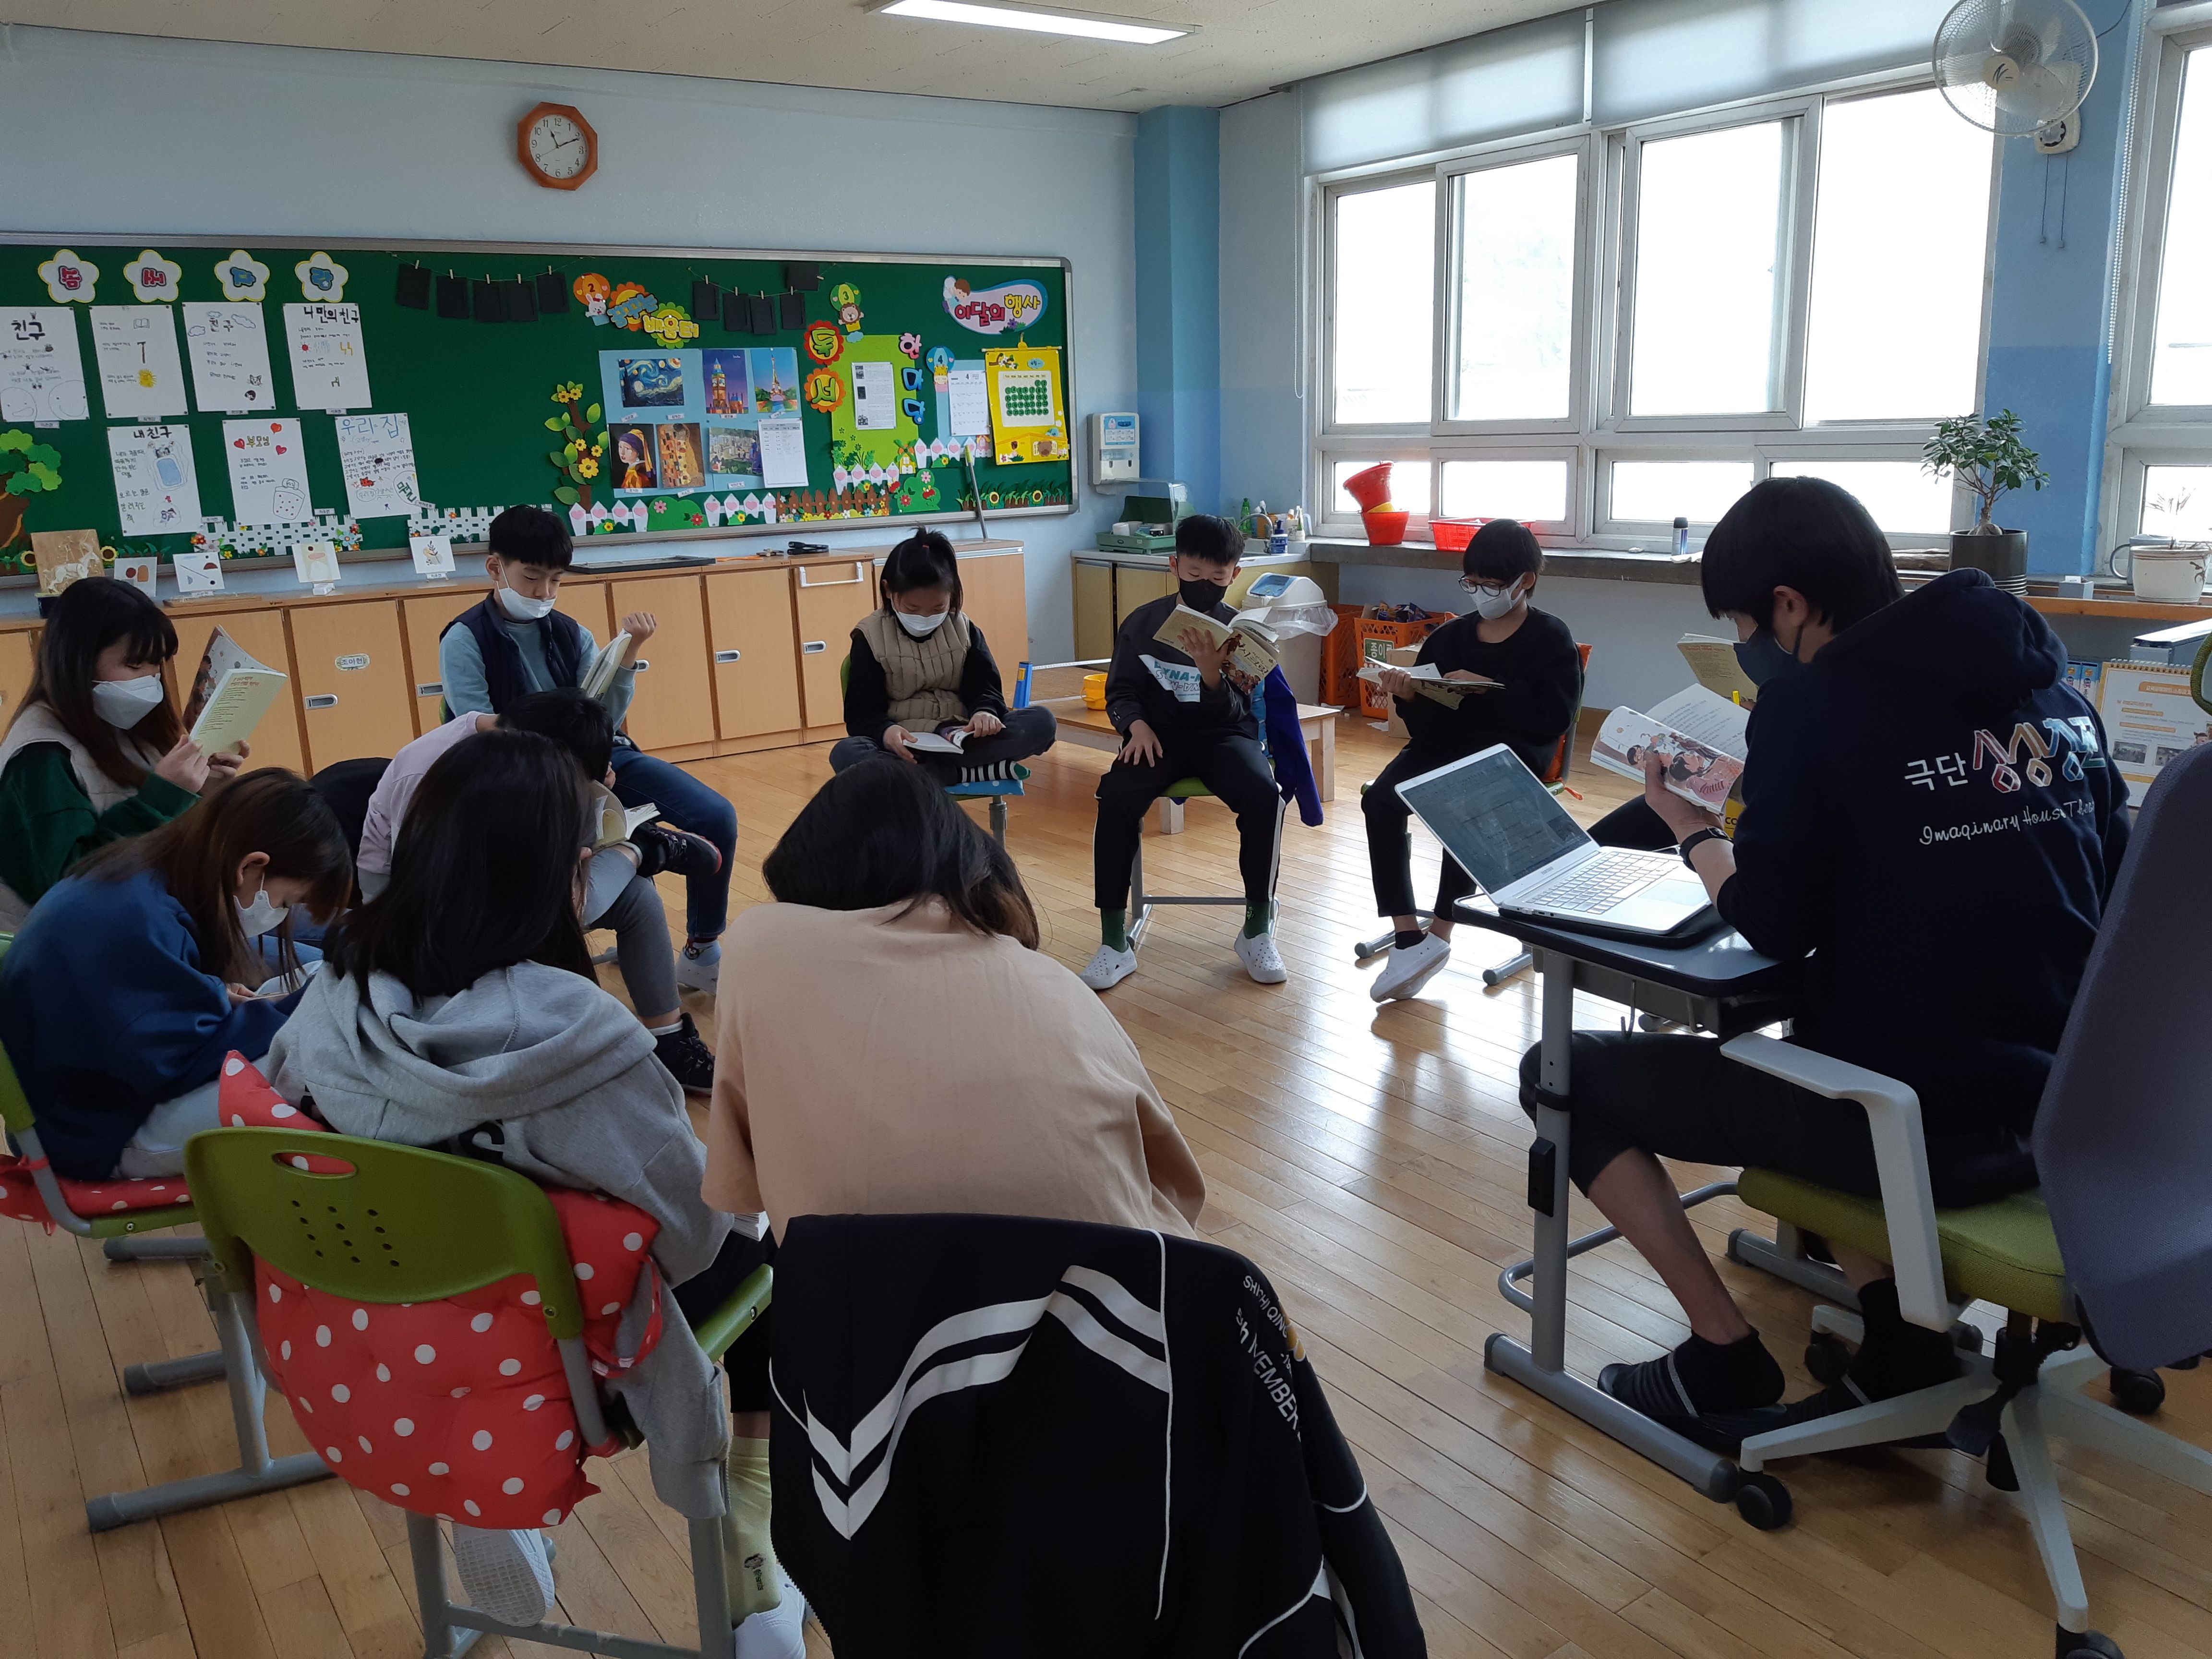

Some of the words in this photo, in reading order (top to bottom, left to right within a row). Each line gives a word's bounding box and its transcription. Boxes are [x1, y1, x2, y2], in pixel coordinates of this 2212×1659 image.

[542, 119, 549, 128] 11
[554, 118, 561, 126] 12
[534, 127, 541, 135] 10
[568, 123, 571, 131] 1
[531, 140, 538, 148] 9
[535, 154, 541, 162] 8
[575, 158, 580, 167] 4
[543, 164, 548, 172] 7
[555, 169, 561, 177] 6
[588, 283, 595, 292] 2
[842, 291, 849, 301] 3
[304, 305, 337, 324] 나만의
[339, 307, 359, 325] 친구
[954, 301, 1005, 327] 이달의
[1004, 294, 1040, 318] 행사
[11, 319, 46, 341] 친구
[643, 315, 699, 339] 배움터
[938, 355, 943, 364] 4
[341, 417, 375, 435] 우리
[379, 414, 400, 439] 집
[133, 429, 144, 439] 내
[146, 426, 172, 439] 친구
[1904, 752, 1968, 791] 극단
[1919, 814, 2020, 845] Imaginary
